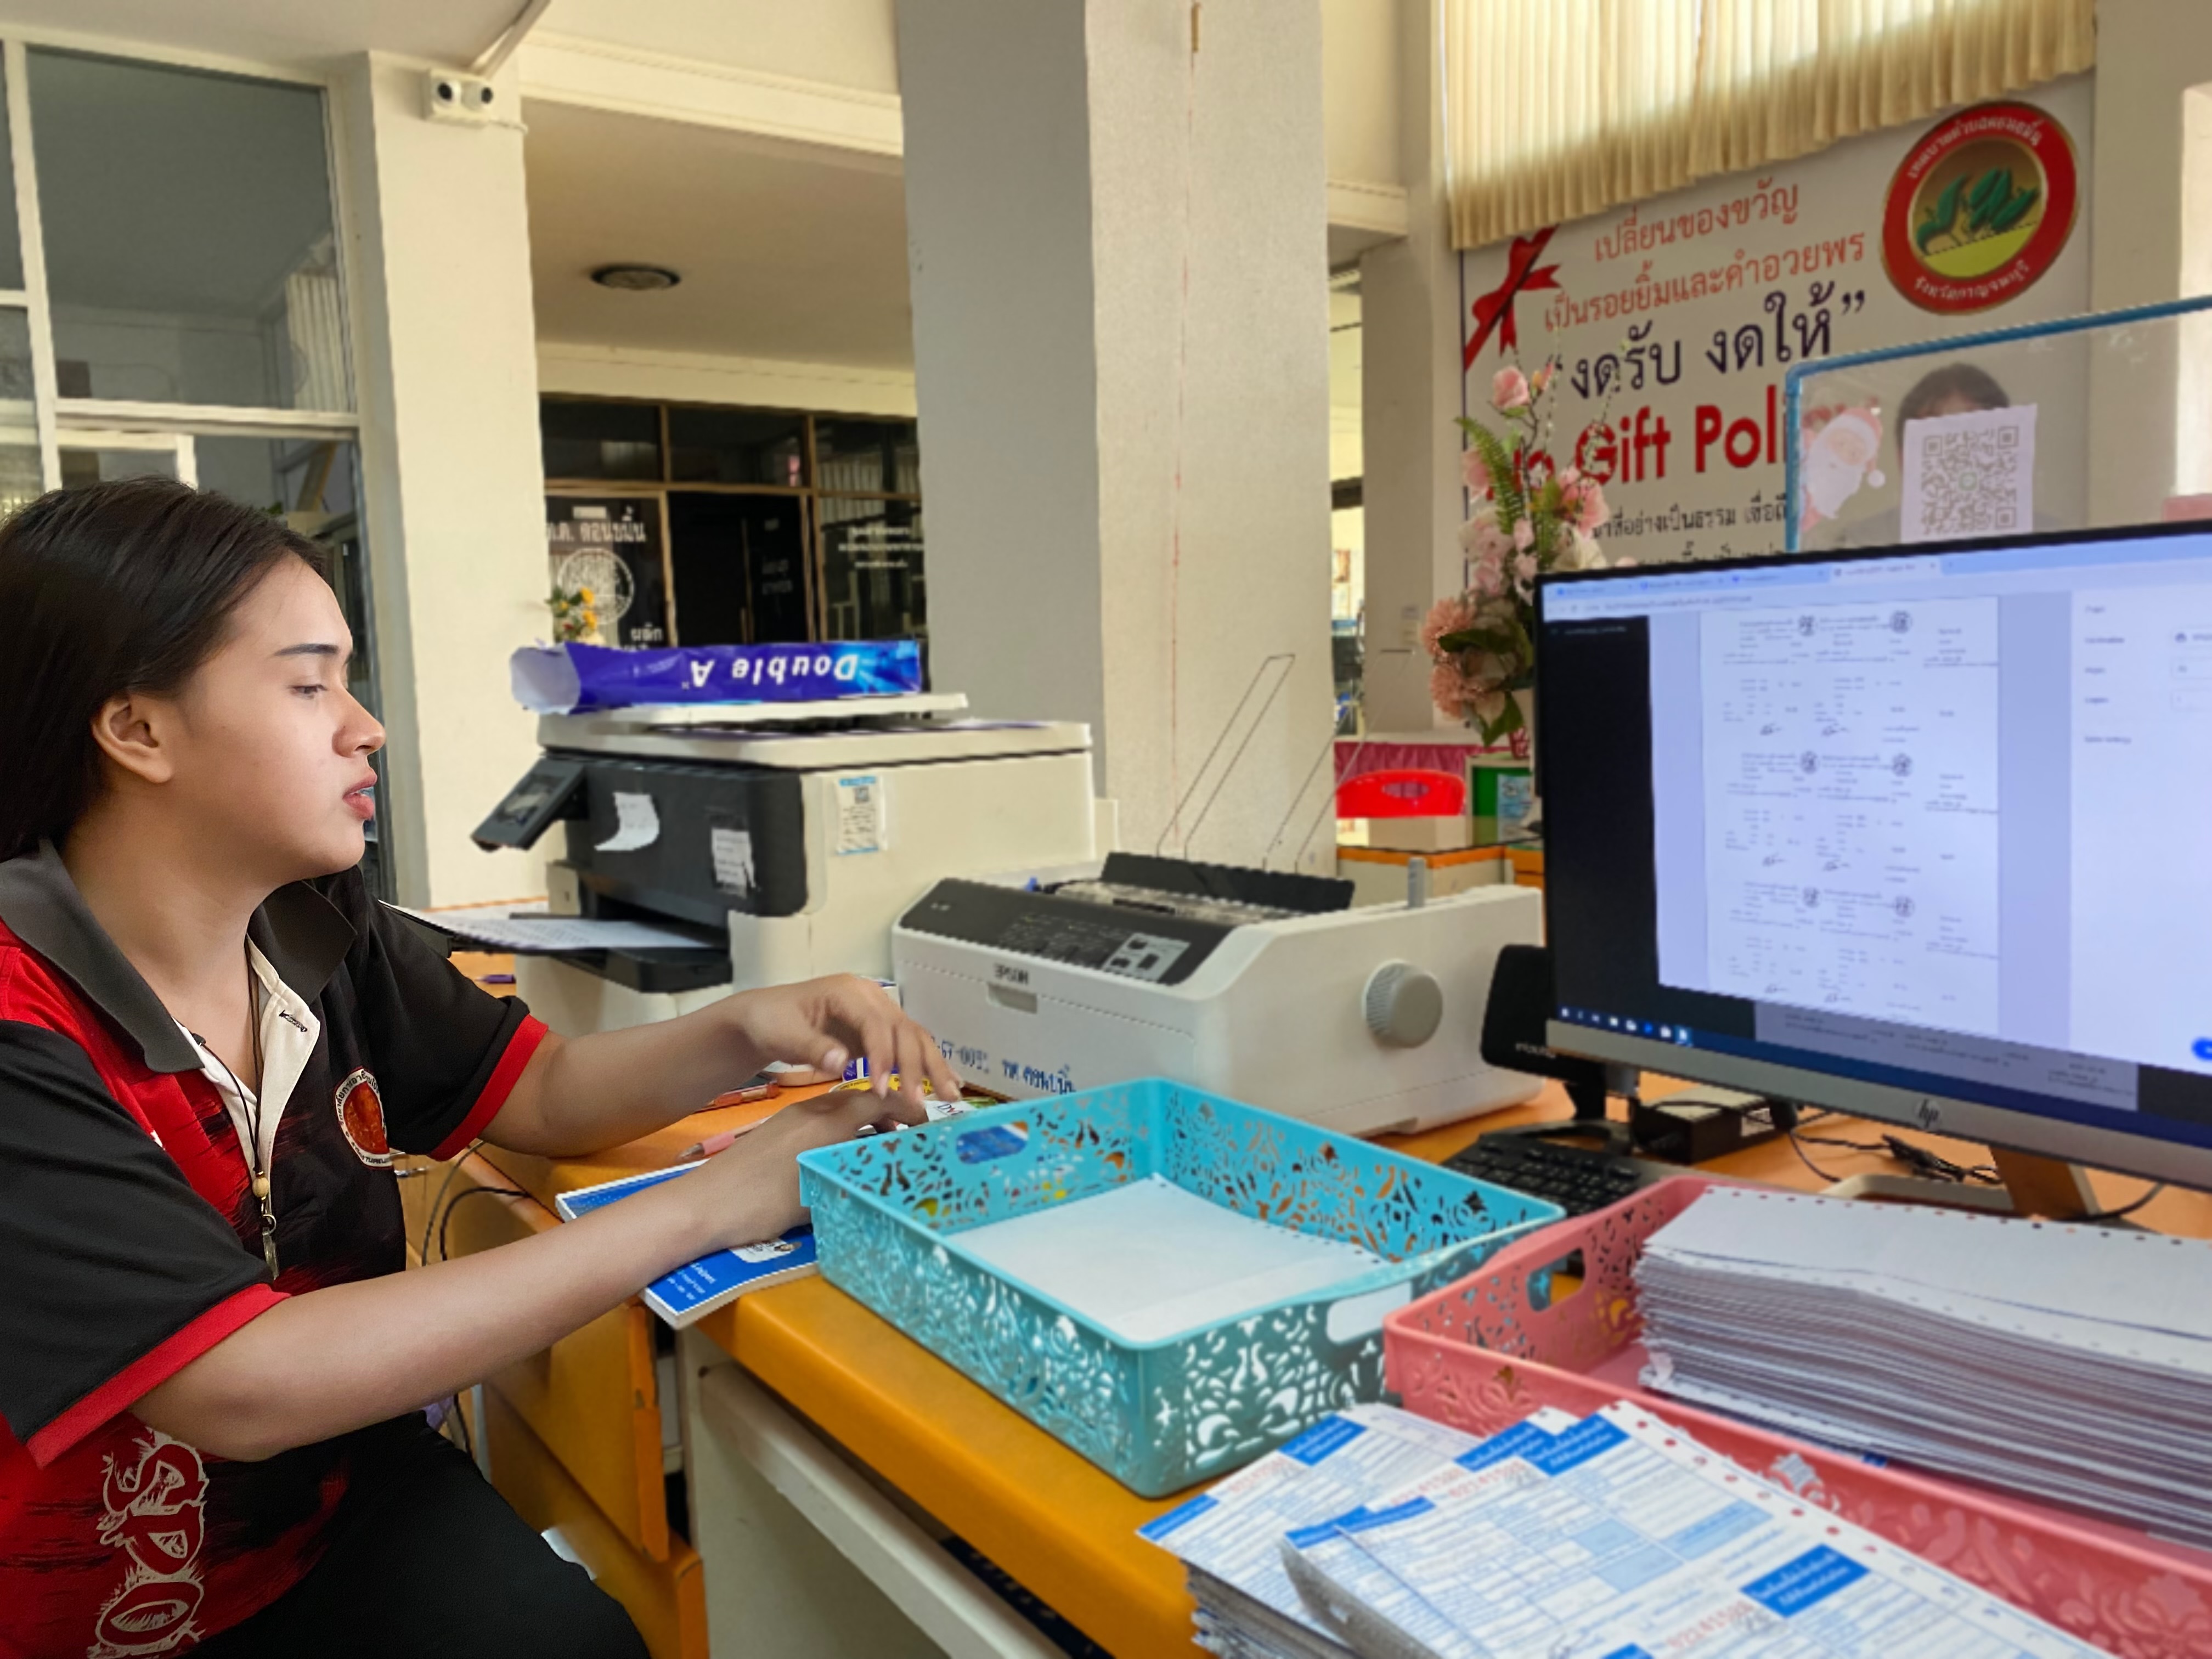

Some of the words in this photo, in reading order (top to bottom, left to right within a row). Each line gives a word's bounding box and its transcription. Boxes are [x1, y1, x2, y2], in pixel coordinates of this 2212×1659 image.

[1594, 176, 1798, 262] เปลี่ยนของขวัญ
[1545, 232, 1865, 332] เป็นรอยยิ้มและคำอวยพร
[1576, 405, 1671, 486] Gift
[689, 659, 715, 689] A
[731, 654, 859, 686] Double
[1919, 1099, 1940, 1129] hp
